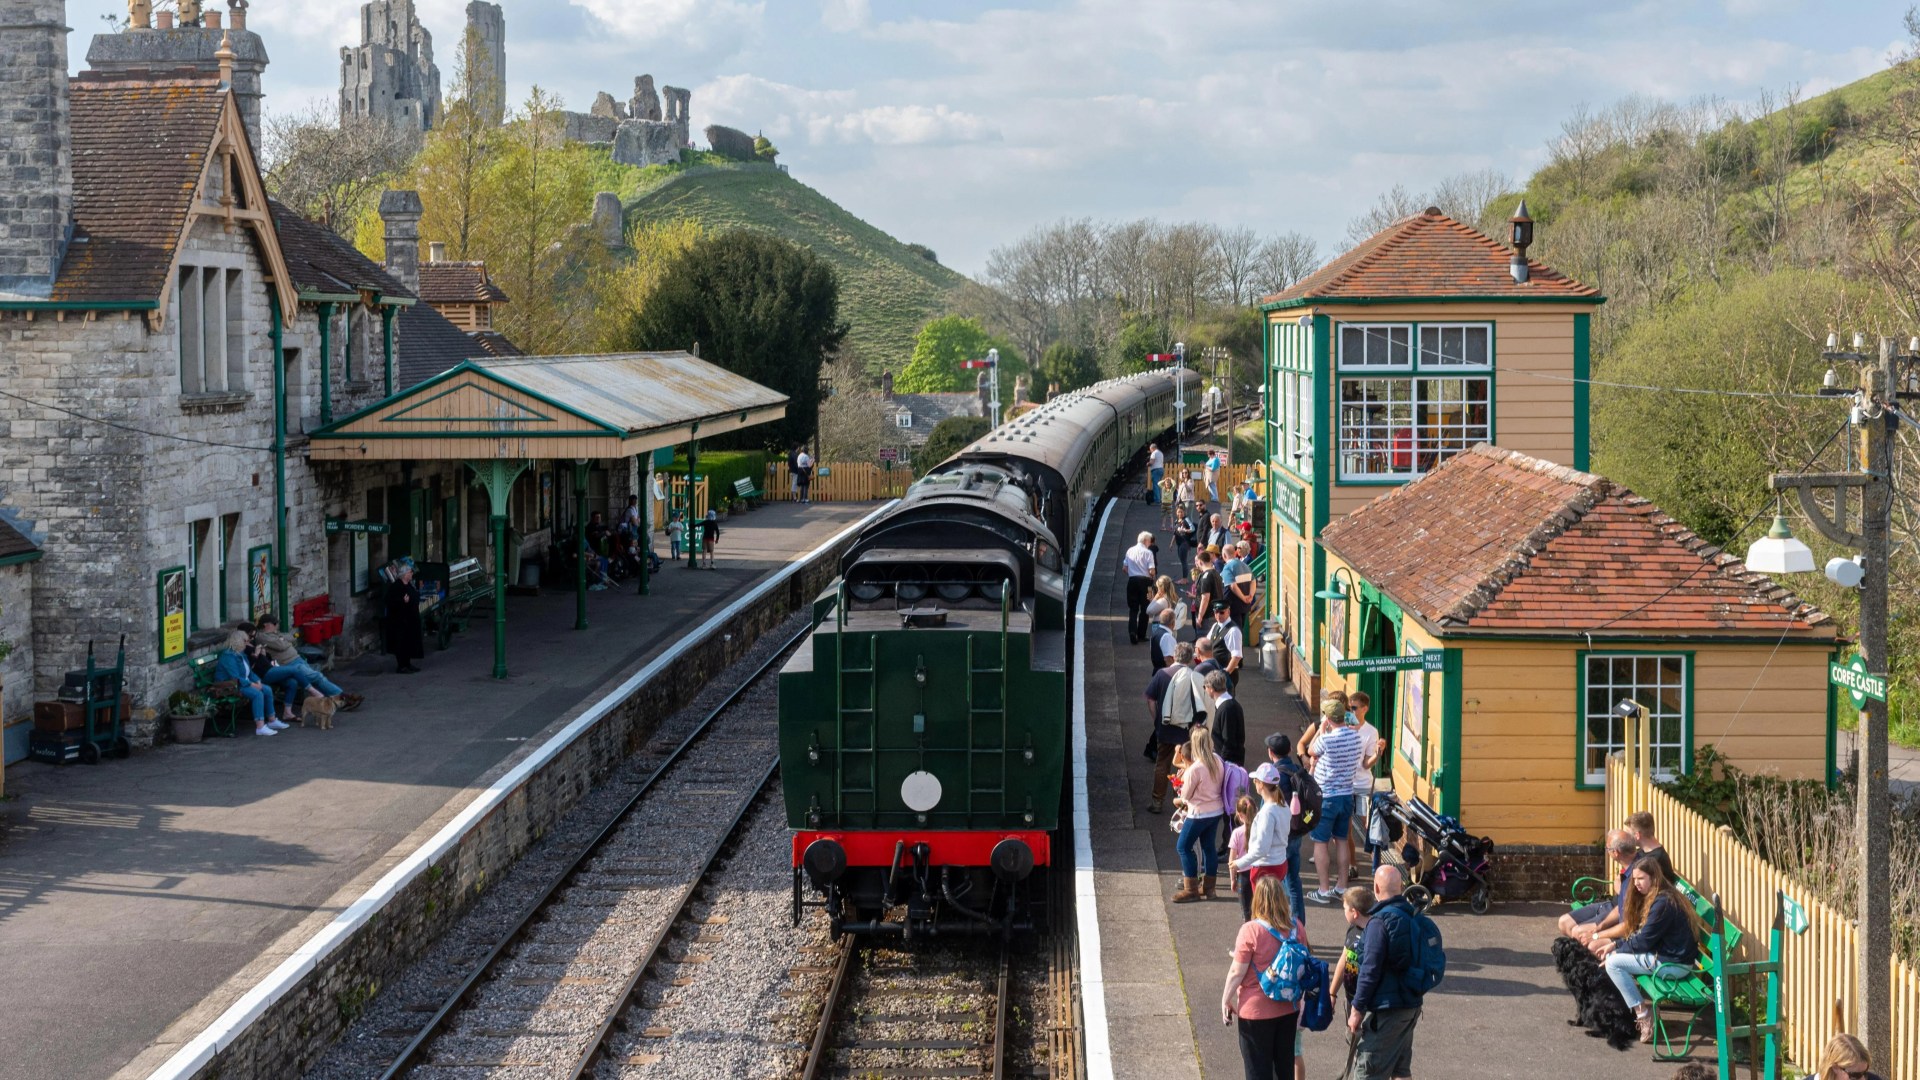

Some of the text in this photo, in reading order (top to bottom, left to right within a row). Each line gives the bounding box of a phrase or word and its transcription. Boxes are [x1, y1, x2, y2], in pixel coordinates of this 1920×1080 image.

[684, 532, 703, 540] OT
[1337, 656, 1424, 668] SWANAGE VIA HARMAN'S CROSS
[1425, 653, 1441, 662] NEXT
[1424, 661, 1443, 670] TRAIN
[1832, 665, 1884, 698] CORFE CASTLE
[1783, 898, 1794, 915] AY
[1783, 910, 1793, 928] UT
